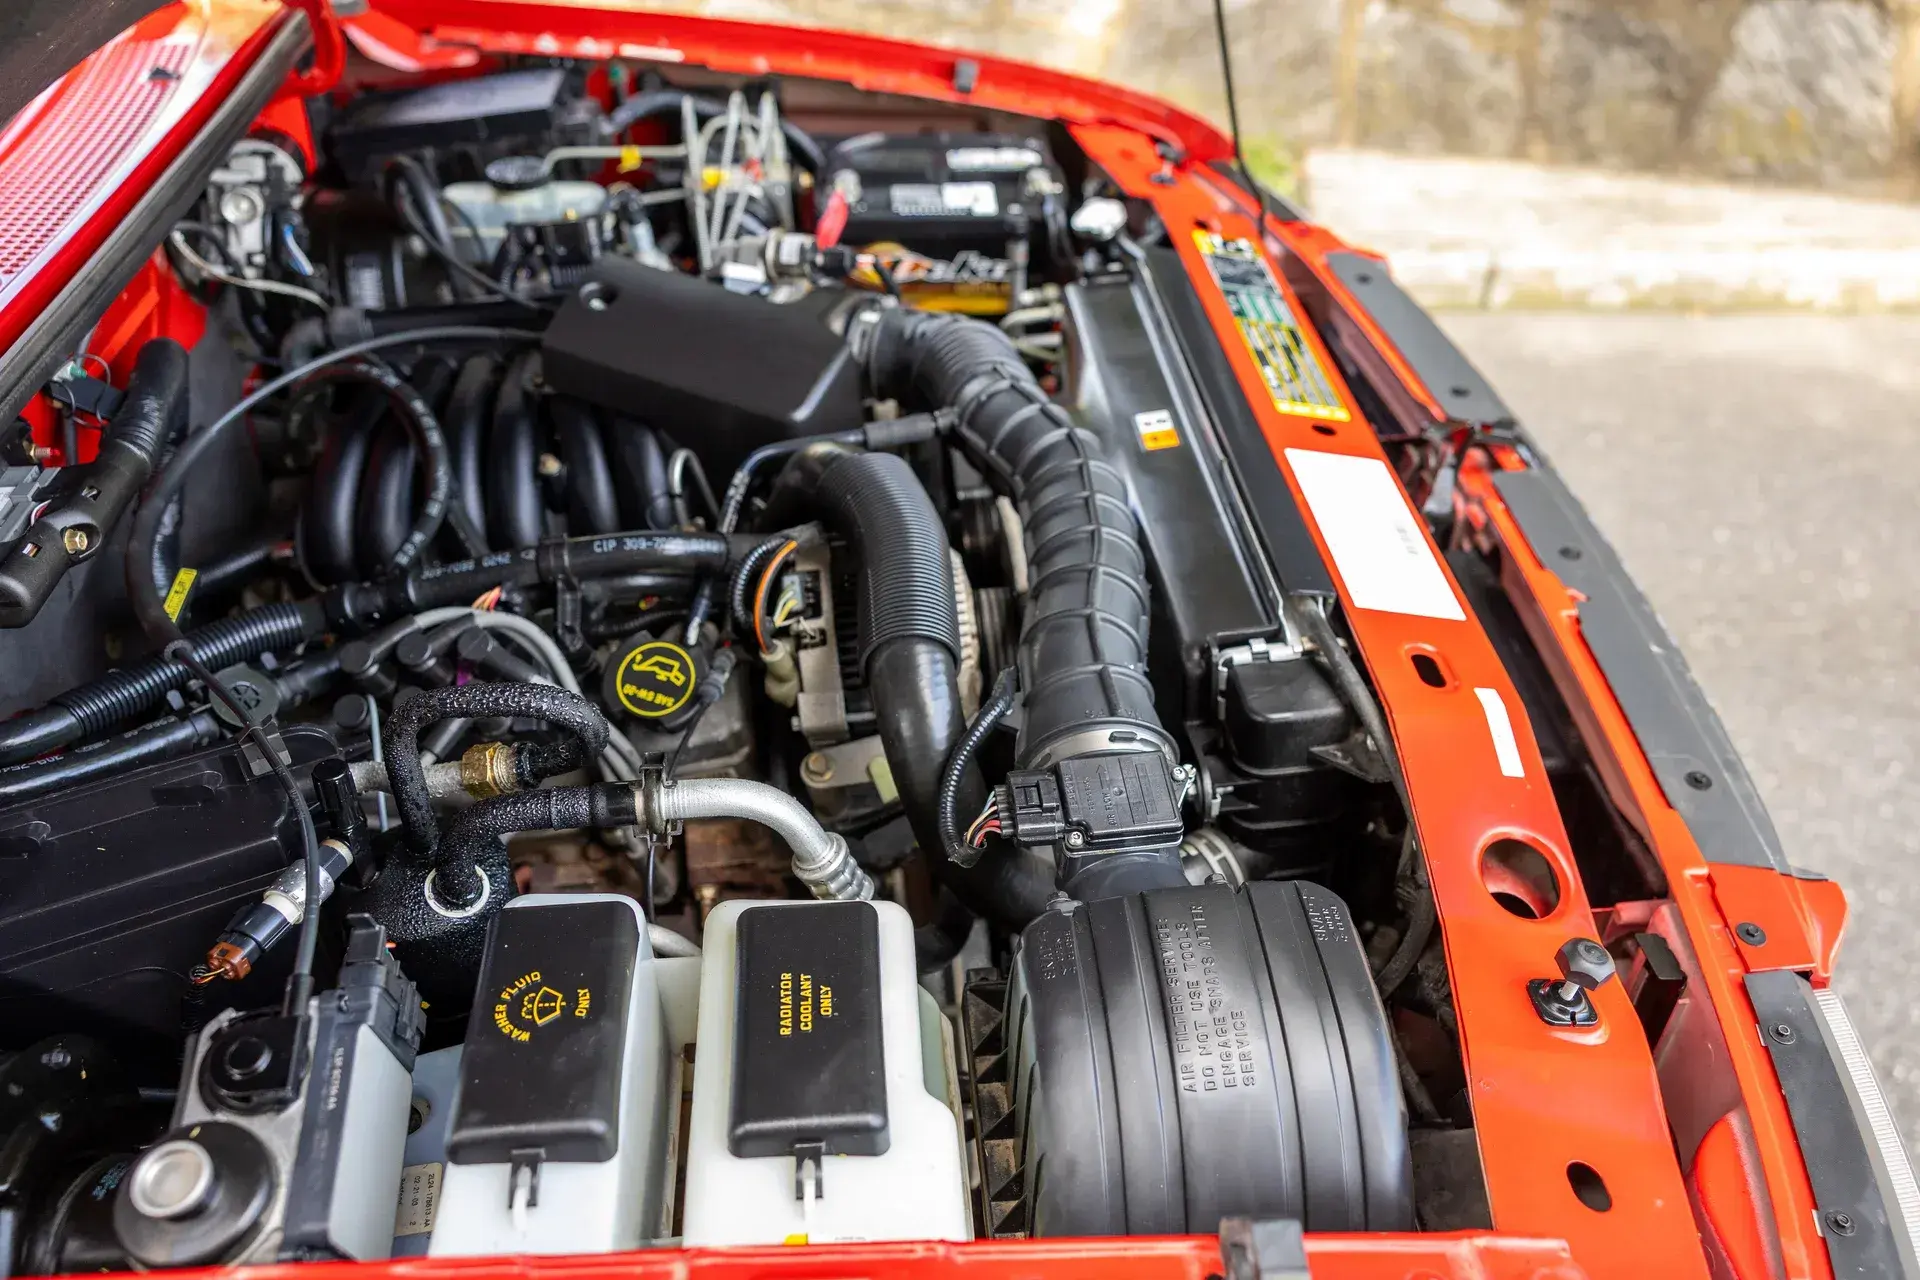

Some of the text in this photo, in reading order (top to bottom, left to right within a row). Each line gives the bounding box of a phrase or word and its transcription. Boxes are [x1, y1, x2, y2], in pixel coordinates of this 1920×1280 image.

[593, 538, 617, 553] CIP
[494, 971, 541, 1041] WASHER FLUID
[575, 988, 590, 1017] ONLY
[780, 972, 792, 1036] RADIATOR
[800, 973, 812, 1032] COOLANT
[820, 985, 832, 1017] ONLY
[1169, 994, 1191, 1054] FILTER
[1175, 922, 1217, 1091] DO NOT USE TOOLS
[1189, 905, 1238, 1088] ENGAGE SNAPS AFTER
[1180, 1062, 1197, 1092] AIR
[1230, 1010, 1256, 1087] SERVICE
